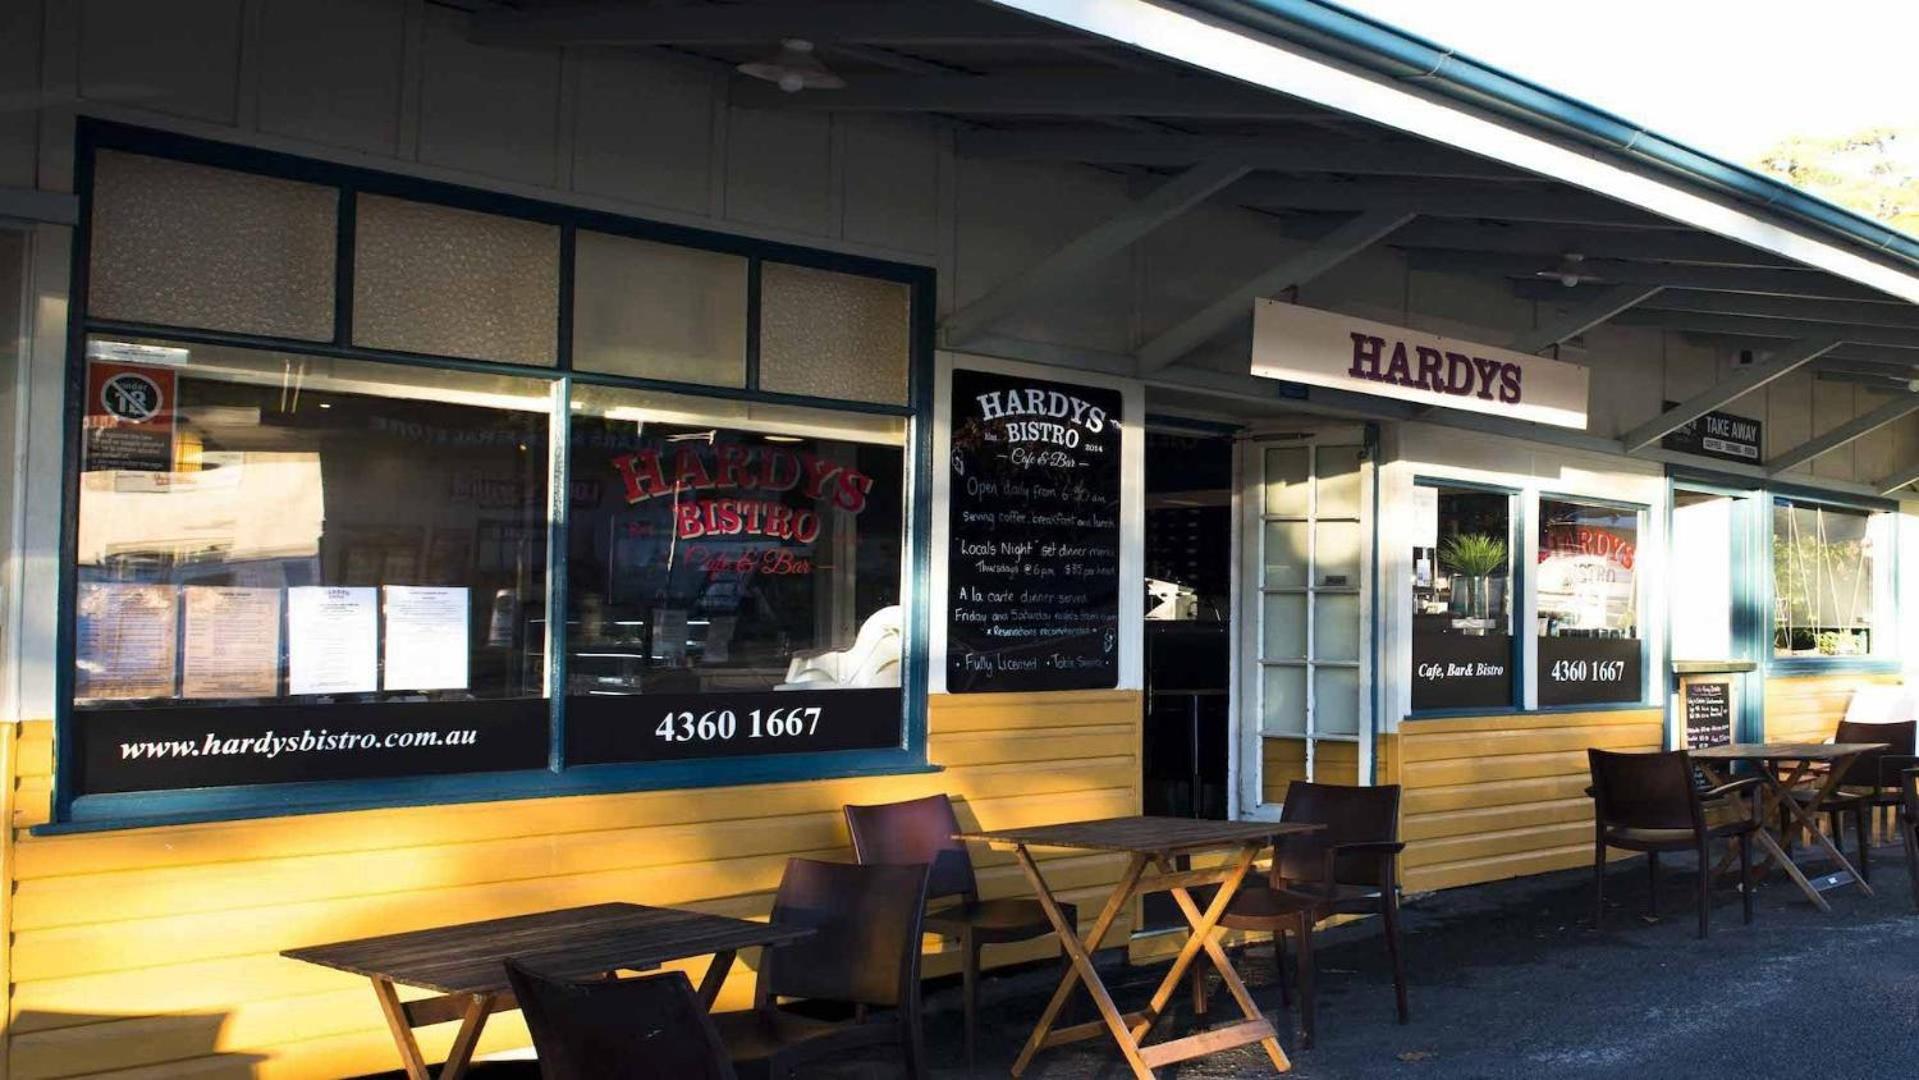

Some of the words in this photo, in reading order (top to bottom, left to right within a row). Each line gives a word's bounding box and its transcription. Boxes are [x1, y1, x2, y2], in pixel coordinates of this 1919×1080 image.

[1347, 331, 1523, 405] HARDYS
[976, 388, 1107, 434] HARDYS
[1005, 421, 1080, 449] BISTRO
[1705, 415, 1730, 437] TAKE
[1730, 420, 1759, 443] AWAY
[1011, 447, 1035, 469] Cafe
[1036, 451, 1049, 465] &
[1050, 451, 1076, 468] Bar
[609, 444, 875, 513] HARDYS
[967, 476, 998, 502] Open
[675, 498, 822, 544] BISTRO
[760, 547, 813, 576] Bar
[959, 586, 968, 600] A
[971, 585, 984, 602] la
[987, 591, 1015, 602] carte
[955, 608, 987, 622] Friday
[965, 653, 993, 678] Fully
[1418, 662, 1444, 680] Cafe,
[1446, 662, 1473, 677] Bar&
[1475, 661, 1504, 677] Bistro
[1551, 660, 1587, 682] 4360
[1591, 660, 1625, 682] 1667
[655, 710, 737, 742] 4360
[747, 706, 823, 739] 1667
[120, 727, 478, 761] www.hardysbistro.com.au
